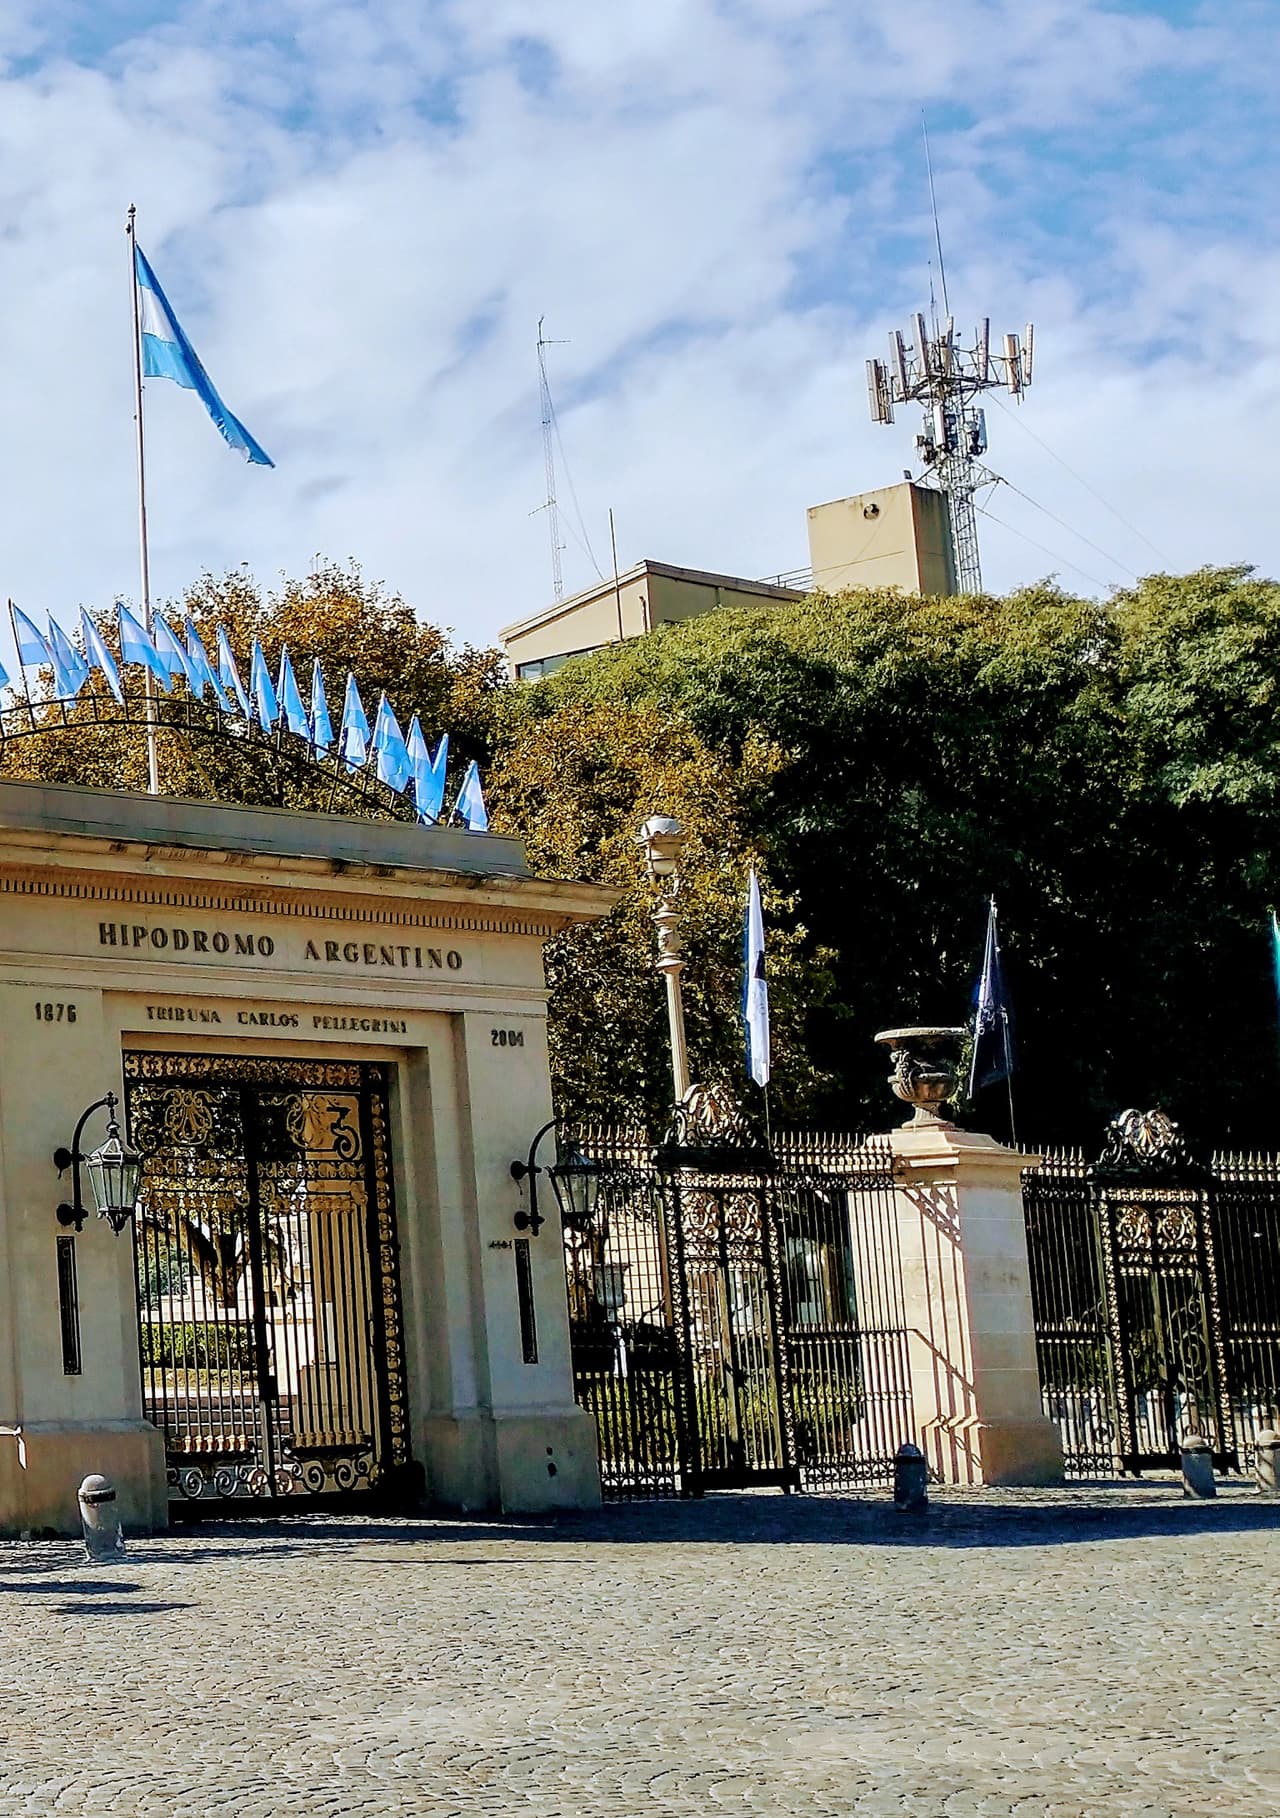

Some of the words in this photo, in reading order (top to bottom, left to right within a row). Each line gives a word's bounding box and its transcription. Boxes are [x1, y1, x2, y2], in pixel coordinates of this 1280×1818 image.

[98, 922, 274, 957] HIPODROMO
[304, 939, 463, 970] ARGENTINO
[34, 1001, 77, 1023] 1876
[145, 1005, 222, 1024] TRIBUNA
[236, 1010, 300, 1028] CARLOS
[312, 1015, 408, 1034] PELLEGRINI
